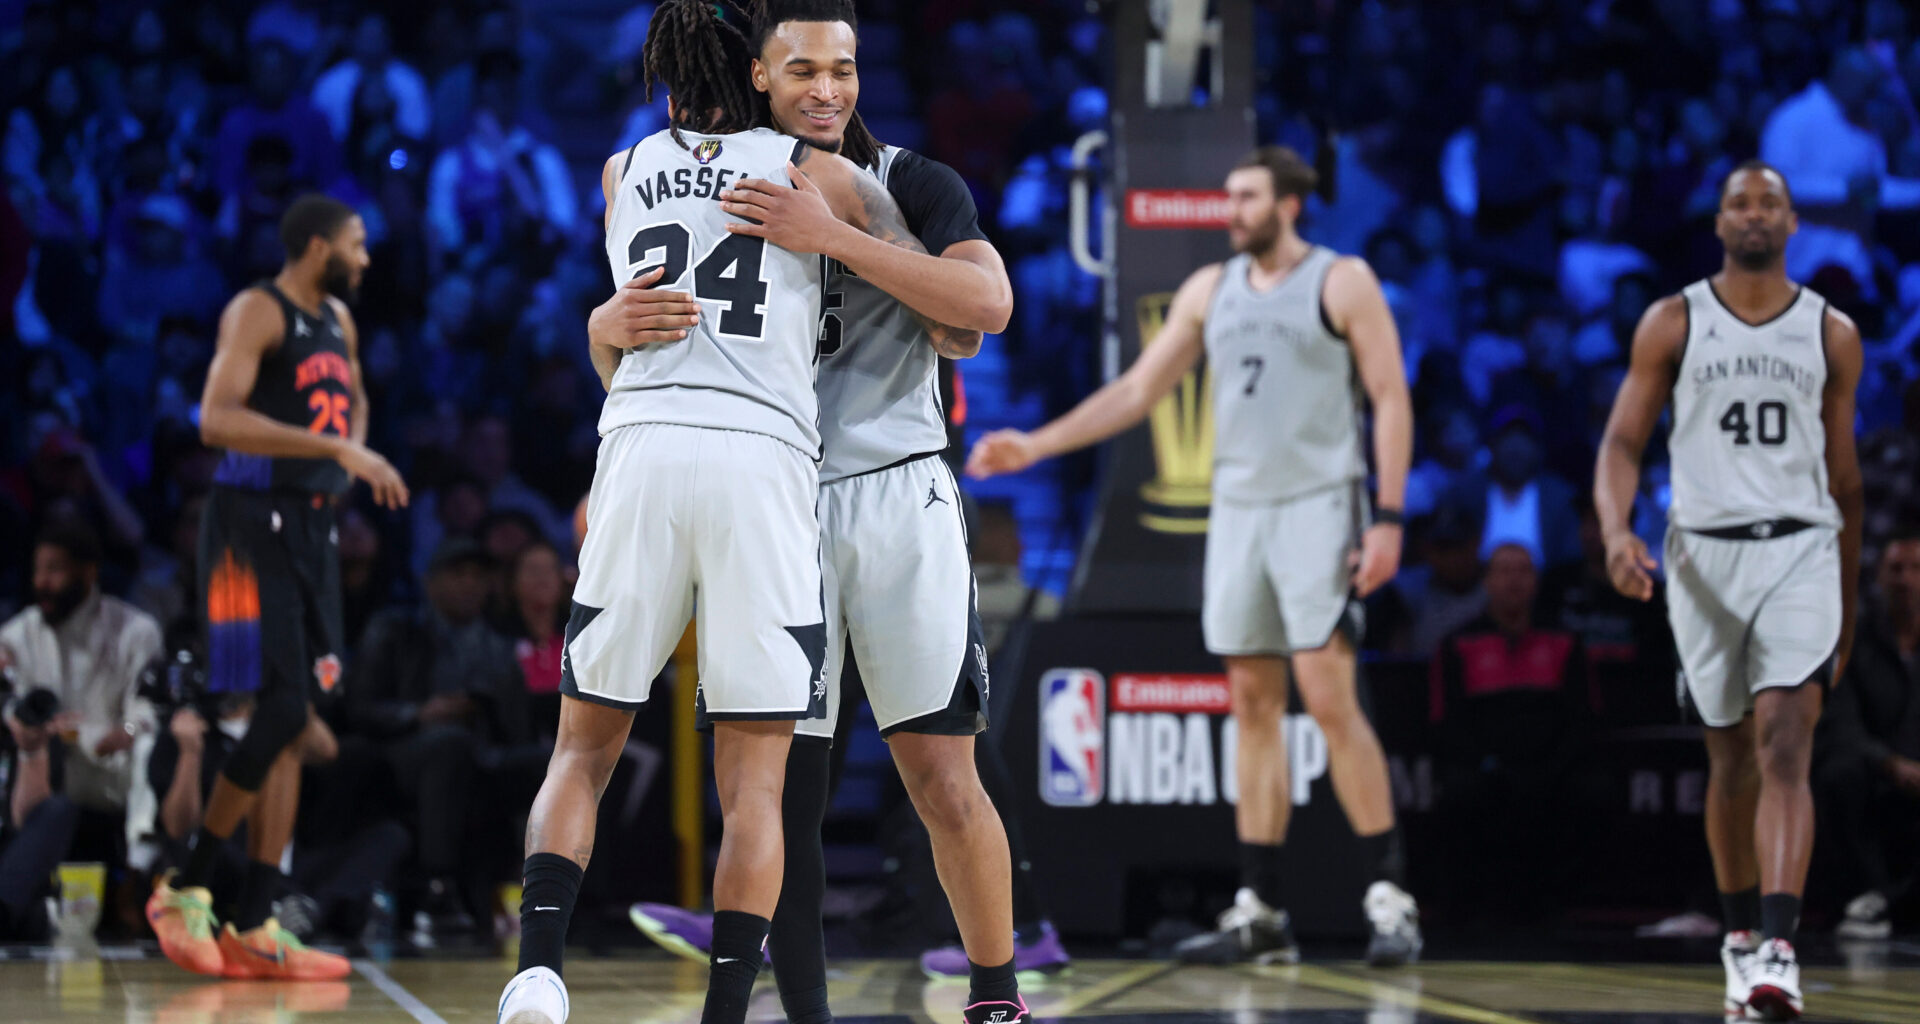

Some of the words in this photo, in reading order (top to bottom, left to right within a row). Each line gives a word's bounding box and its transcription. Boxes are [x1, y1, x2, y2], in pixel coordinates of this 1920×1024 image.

[635, 166, 748, 210] VASSE
[1133, 192, 1235, 222] Emirate
[626, 219, 772, 342] 24
[1242, 355, 1265, 396] 7
[1693, 359, 1729, 394] SAN
[1734, 354, 1816, 399] ANTONIO
[308, 388, 350, 440] 25
[1720, 401, 1788, 446] 40
[1117, 676, 1231, 708] Emirates
[1109, 712, 1217, 805] NBA
[1221, 713, 1330, 805] CP
